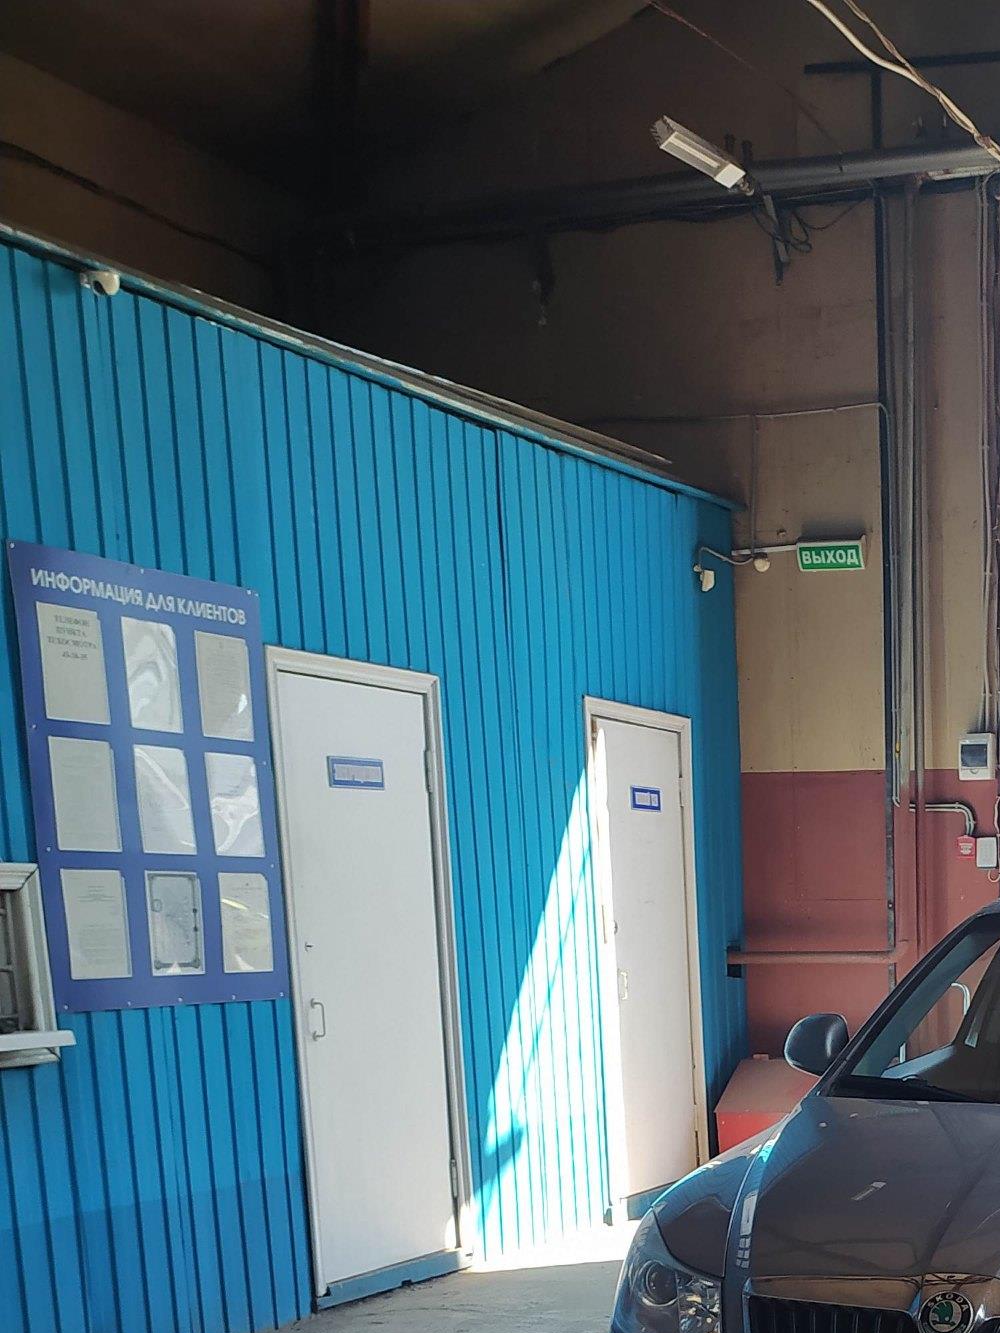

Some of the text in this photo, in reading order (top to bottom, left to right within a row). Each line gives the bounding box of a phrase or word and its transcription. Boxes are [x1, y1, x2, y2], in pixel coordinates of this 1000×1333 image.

[801, 549, 859, 565] ВЫХОД
[30, 567, 248, 626] ИНФОРМАЦИЯ ДЛЯ КЛИЕНТОВ
